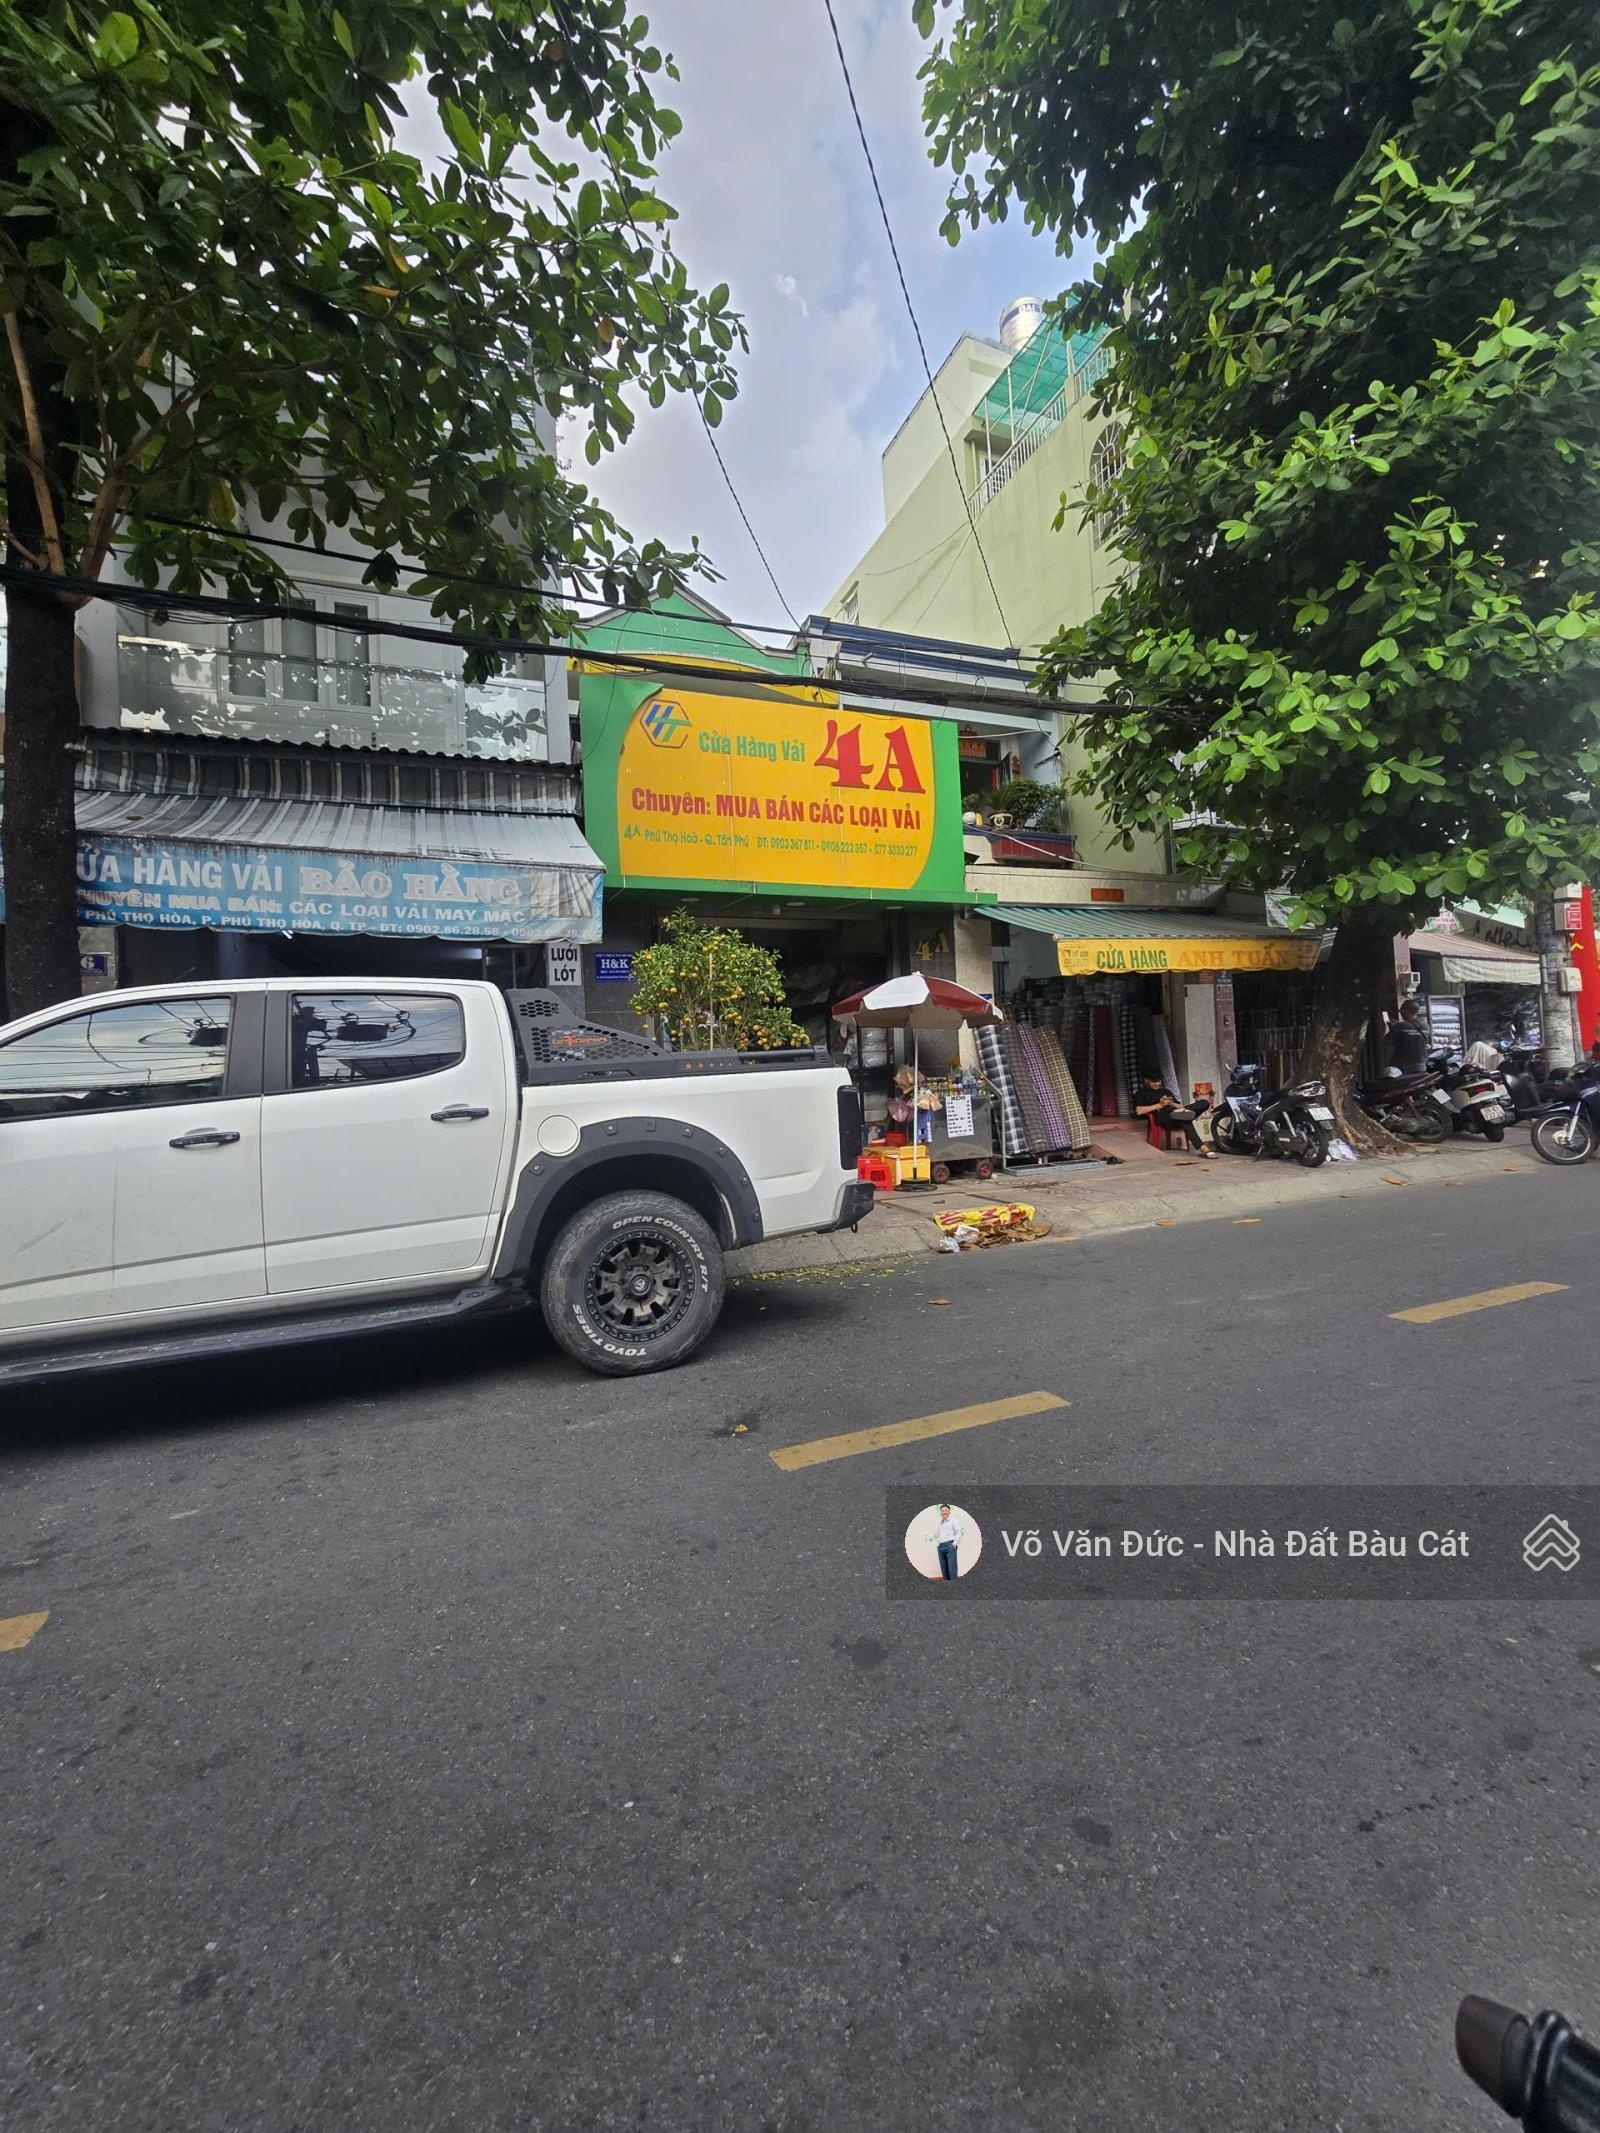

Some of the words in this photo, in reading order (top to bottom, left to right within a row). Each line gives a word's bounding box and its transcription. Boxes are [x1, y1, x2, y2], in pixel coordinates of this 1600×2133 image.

[699, 730, 731, 755] Cửa
[736, 735, 777, 762] Hàng
[781, 738, 806, 763] Vải
[814, 719, 926, 795] 4A
[632, 787, 711, 816] Chuyên:
[716, 795, 760, 819] MUA
[766, 795, 805, 822] BÁN
[809, 798, 844, 825] CÁC
[850, 805, 888, 833] LOẠI
[893, 803, 921, 830] VẢI
[624, 824, 641, 840] 4A
[76, 843, 122, 883] ỬA
[133, 851, 222, 889] HÀNG
[231, 854, 282, 892] VẢI
[300, 860, 393, 898] BẢO
[403, 862, 521, 905] HÀNG
[76, 888, 161, 908] HUYÊN
[168, 894, 221, 911] MUA
[289, 900, 333, 916] CÁC
[340, 903, 388, 919] LOẠI
[394, 903, 428, 920] VẢI
[435, 908, 476, 921] MAY
[85, 909, 116, 921] PHÚ
[122, 911, 154, 924] THỌ
[221, 915, 251, 926] PHÚ
[256, 917, 287, 928] THỌ
[380, 923, 402, 932] ĐT:
[601, 959, 629, 969] H&K
[1096, 944, 1126, 969] CỬA
[1129, 946, 1168, 969] HÀNG
[1177, 950, 1225, 967] ANH
[554, 964, 576, 982] LÓT
[612, 1215, 653, 1230] OPEN
[654, 1217, 705, 1261] COUNTRY
[572, 1304, 604, 1346] TIRES
[603, 1343, 647, 1357] TOYO
